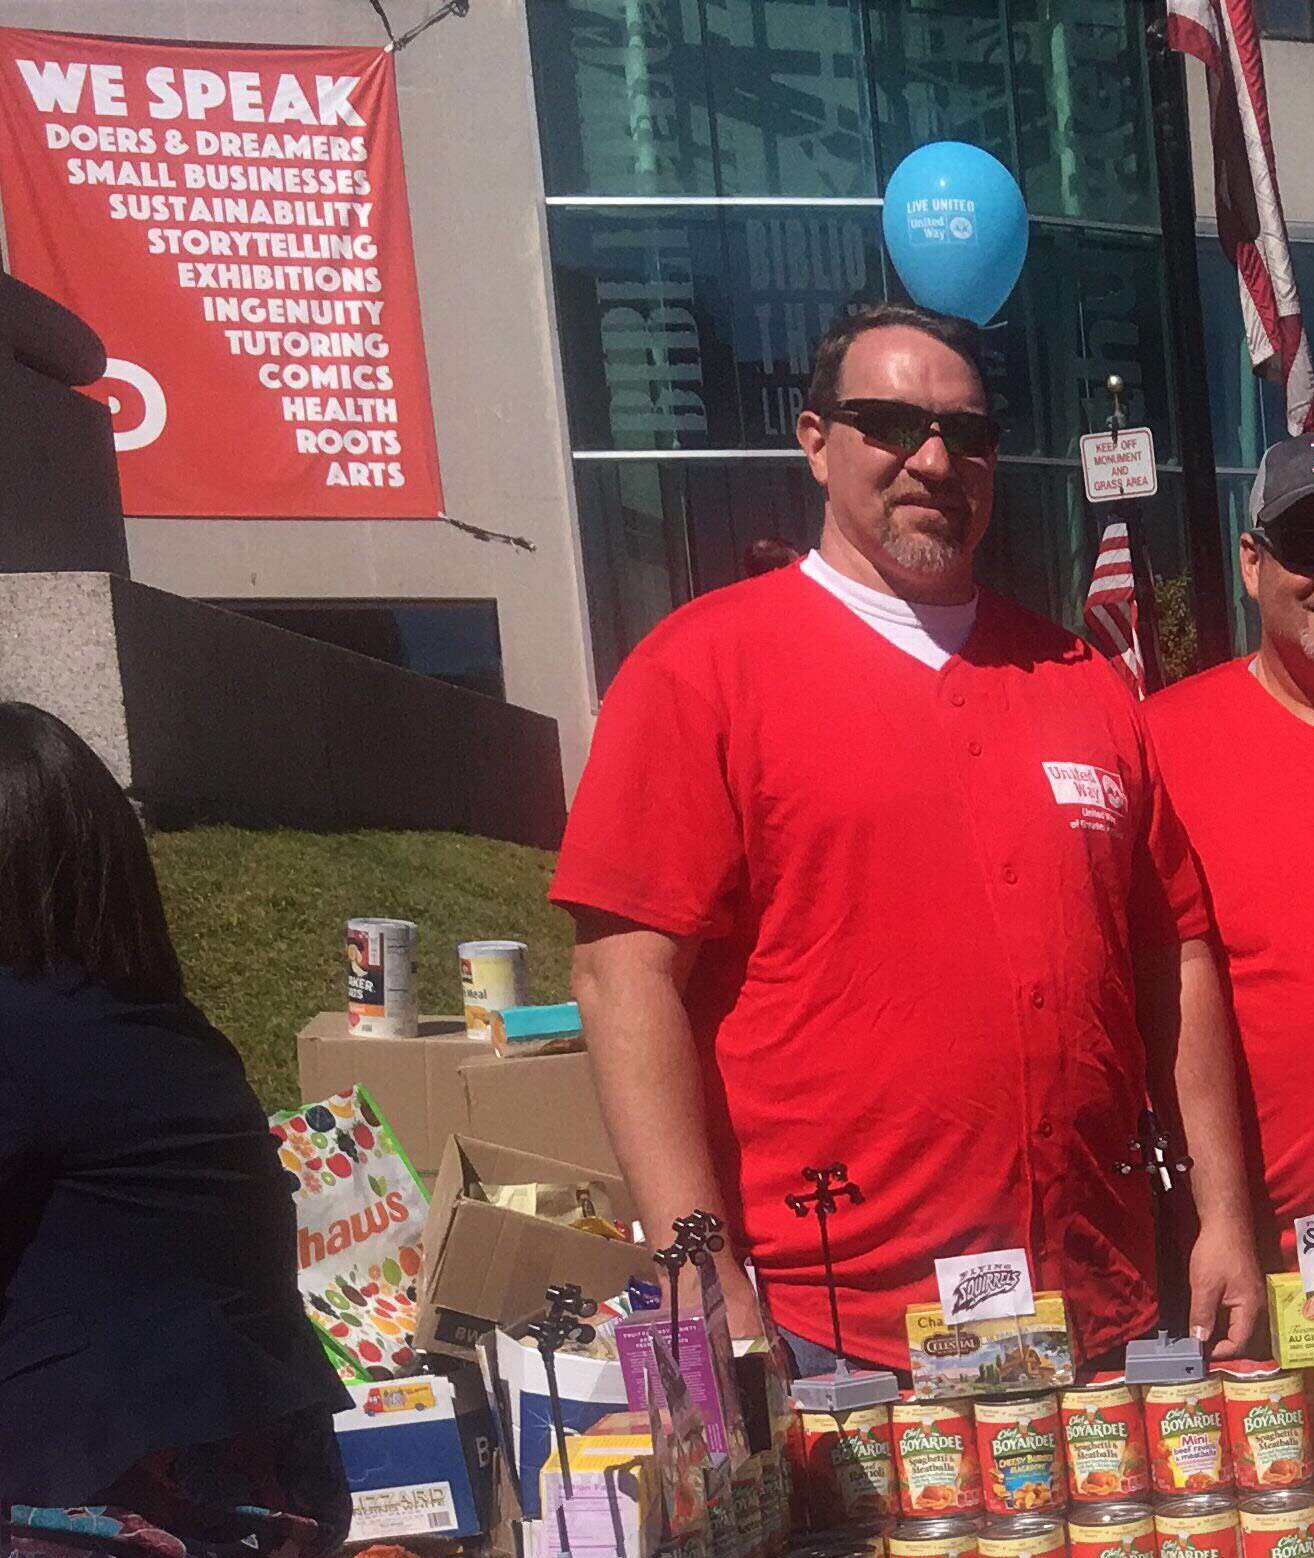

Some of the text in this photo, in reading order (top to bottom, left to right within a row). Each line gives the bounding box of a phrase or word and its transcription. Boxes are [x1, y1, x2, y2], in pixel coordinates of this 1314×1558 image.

[16, 59, 366, 127] WE SPEAK
[46, 123, 367, 162] DOERS & DREAMERS
[68, 159, 371, 195] SMALL BUSINESSES
[109, 194, 373, 228] SUSTAINABILITY
[907, 199, 974, 214] LIVE UNITED
[909, 216, 945, 229] United
[148, 229, 378, 260] STORYTELLING
[924, 228, 945, 240] Way
[179, 262, 382, 293] EXHIBITIONS
[203, 296, 384, 325] INGENUITY
[225, 329, 389, 359] TUTORING
[258, 363, 394, 390] COMICS
[282, 396, 398, 423] HEALTH
[296, 428, 401, 455] ROOTS
[1096, 439, 1137, 452] KEEP OFF
[1094, 452, 1142, 465] MONUMENT
[326, 462, 405, 487] ARTS
[1112, 467, 1128, 476] AND
[1094, 476, 1148, 491] GRASS AREA
[1050, 767, 1096, 783] United
[1074, 782, 1100, 802] Way
[960, 1264, 1012, 1279] FLYING
[953, 1271, 1021, 1310] SQUIRRELS
[1289, 1335, 1301, 1343] AU
[1165, 1408, 1185, 1421] Chef
[1181, 1435, 1209, 1447] Mini
